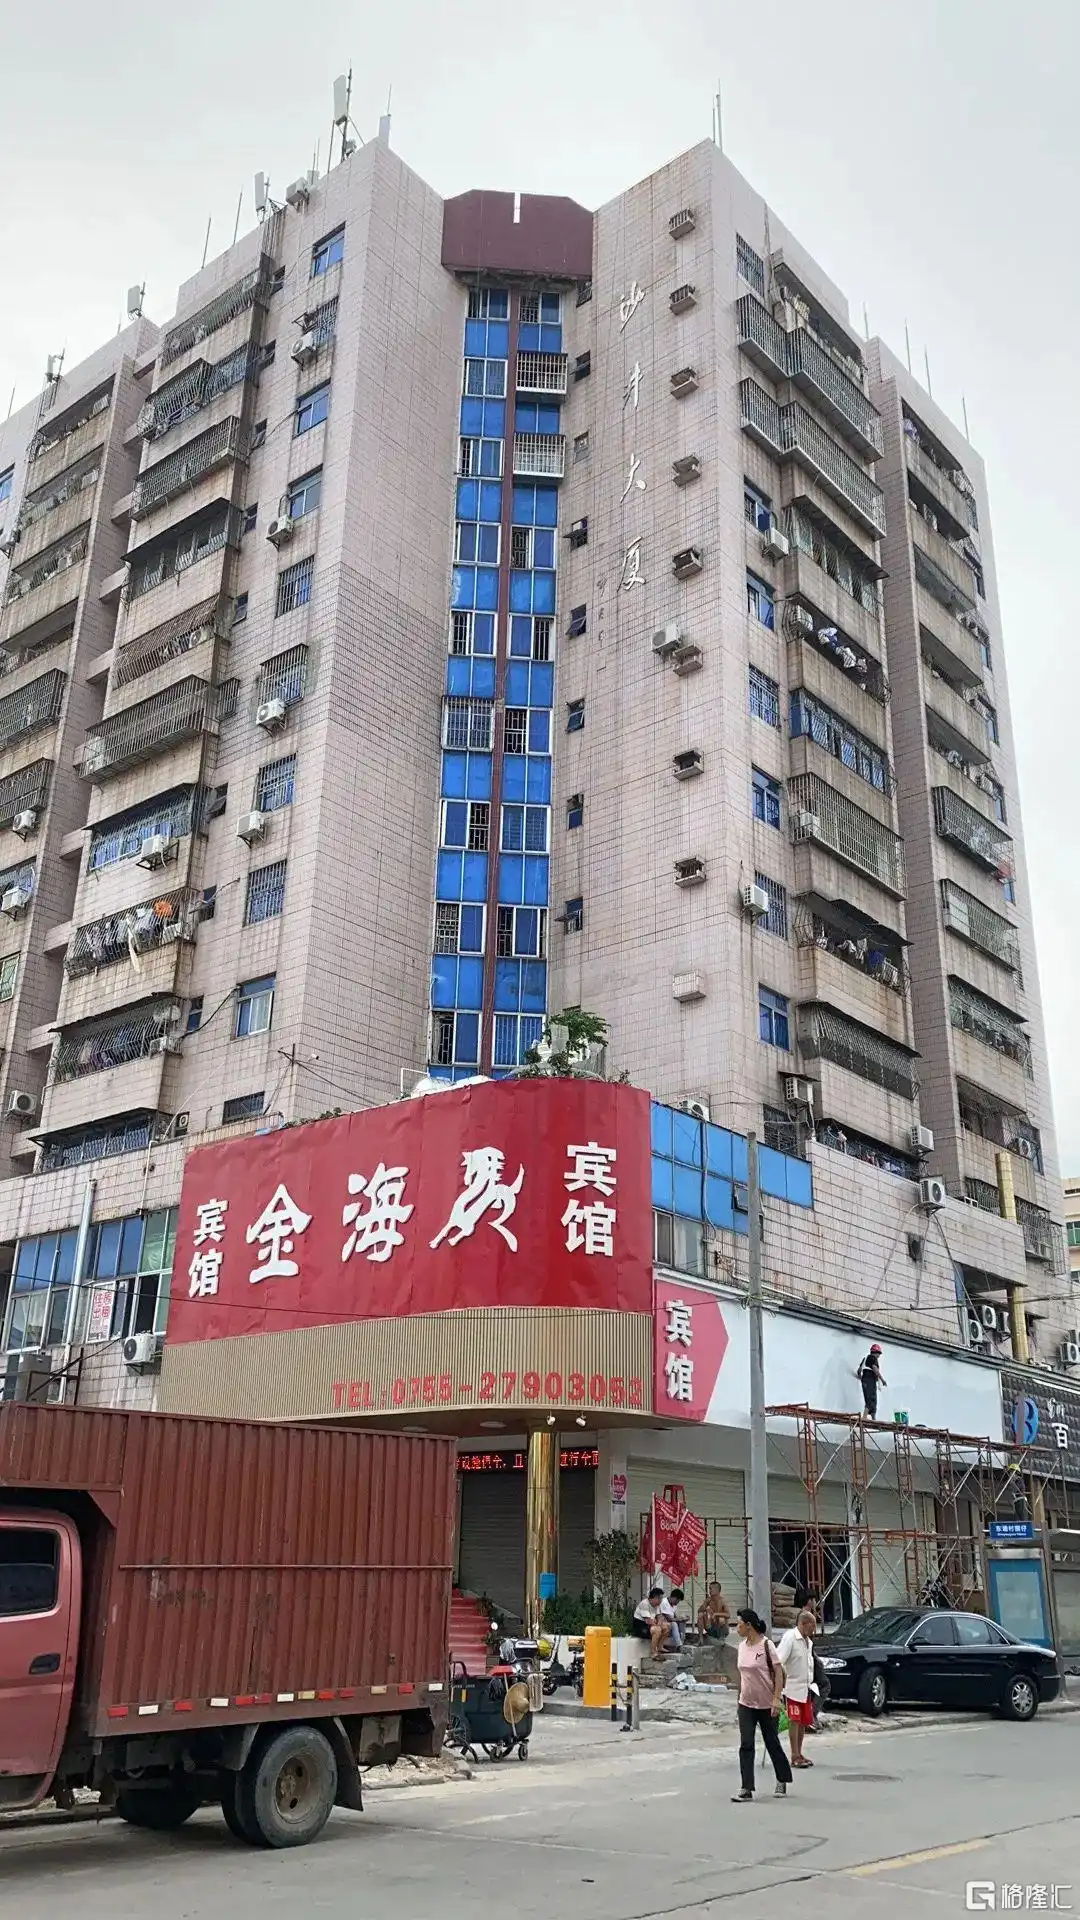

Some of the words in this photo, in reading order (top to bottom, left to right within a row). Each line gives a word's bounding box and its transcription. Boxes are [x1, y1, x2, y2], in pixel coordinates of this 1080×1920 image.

[188, 1198, 229, 1298] 宾馆
[560, 1141, 617, 1257] 宾馆
[665, 1299, 694, 1402] 宾馆
